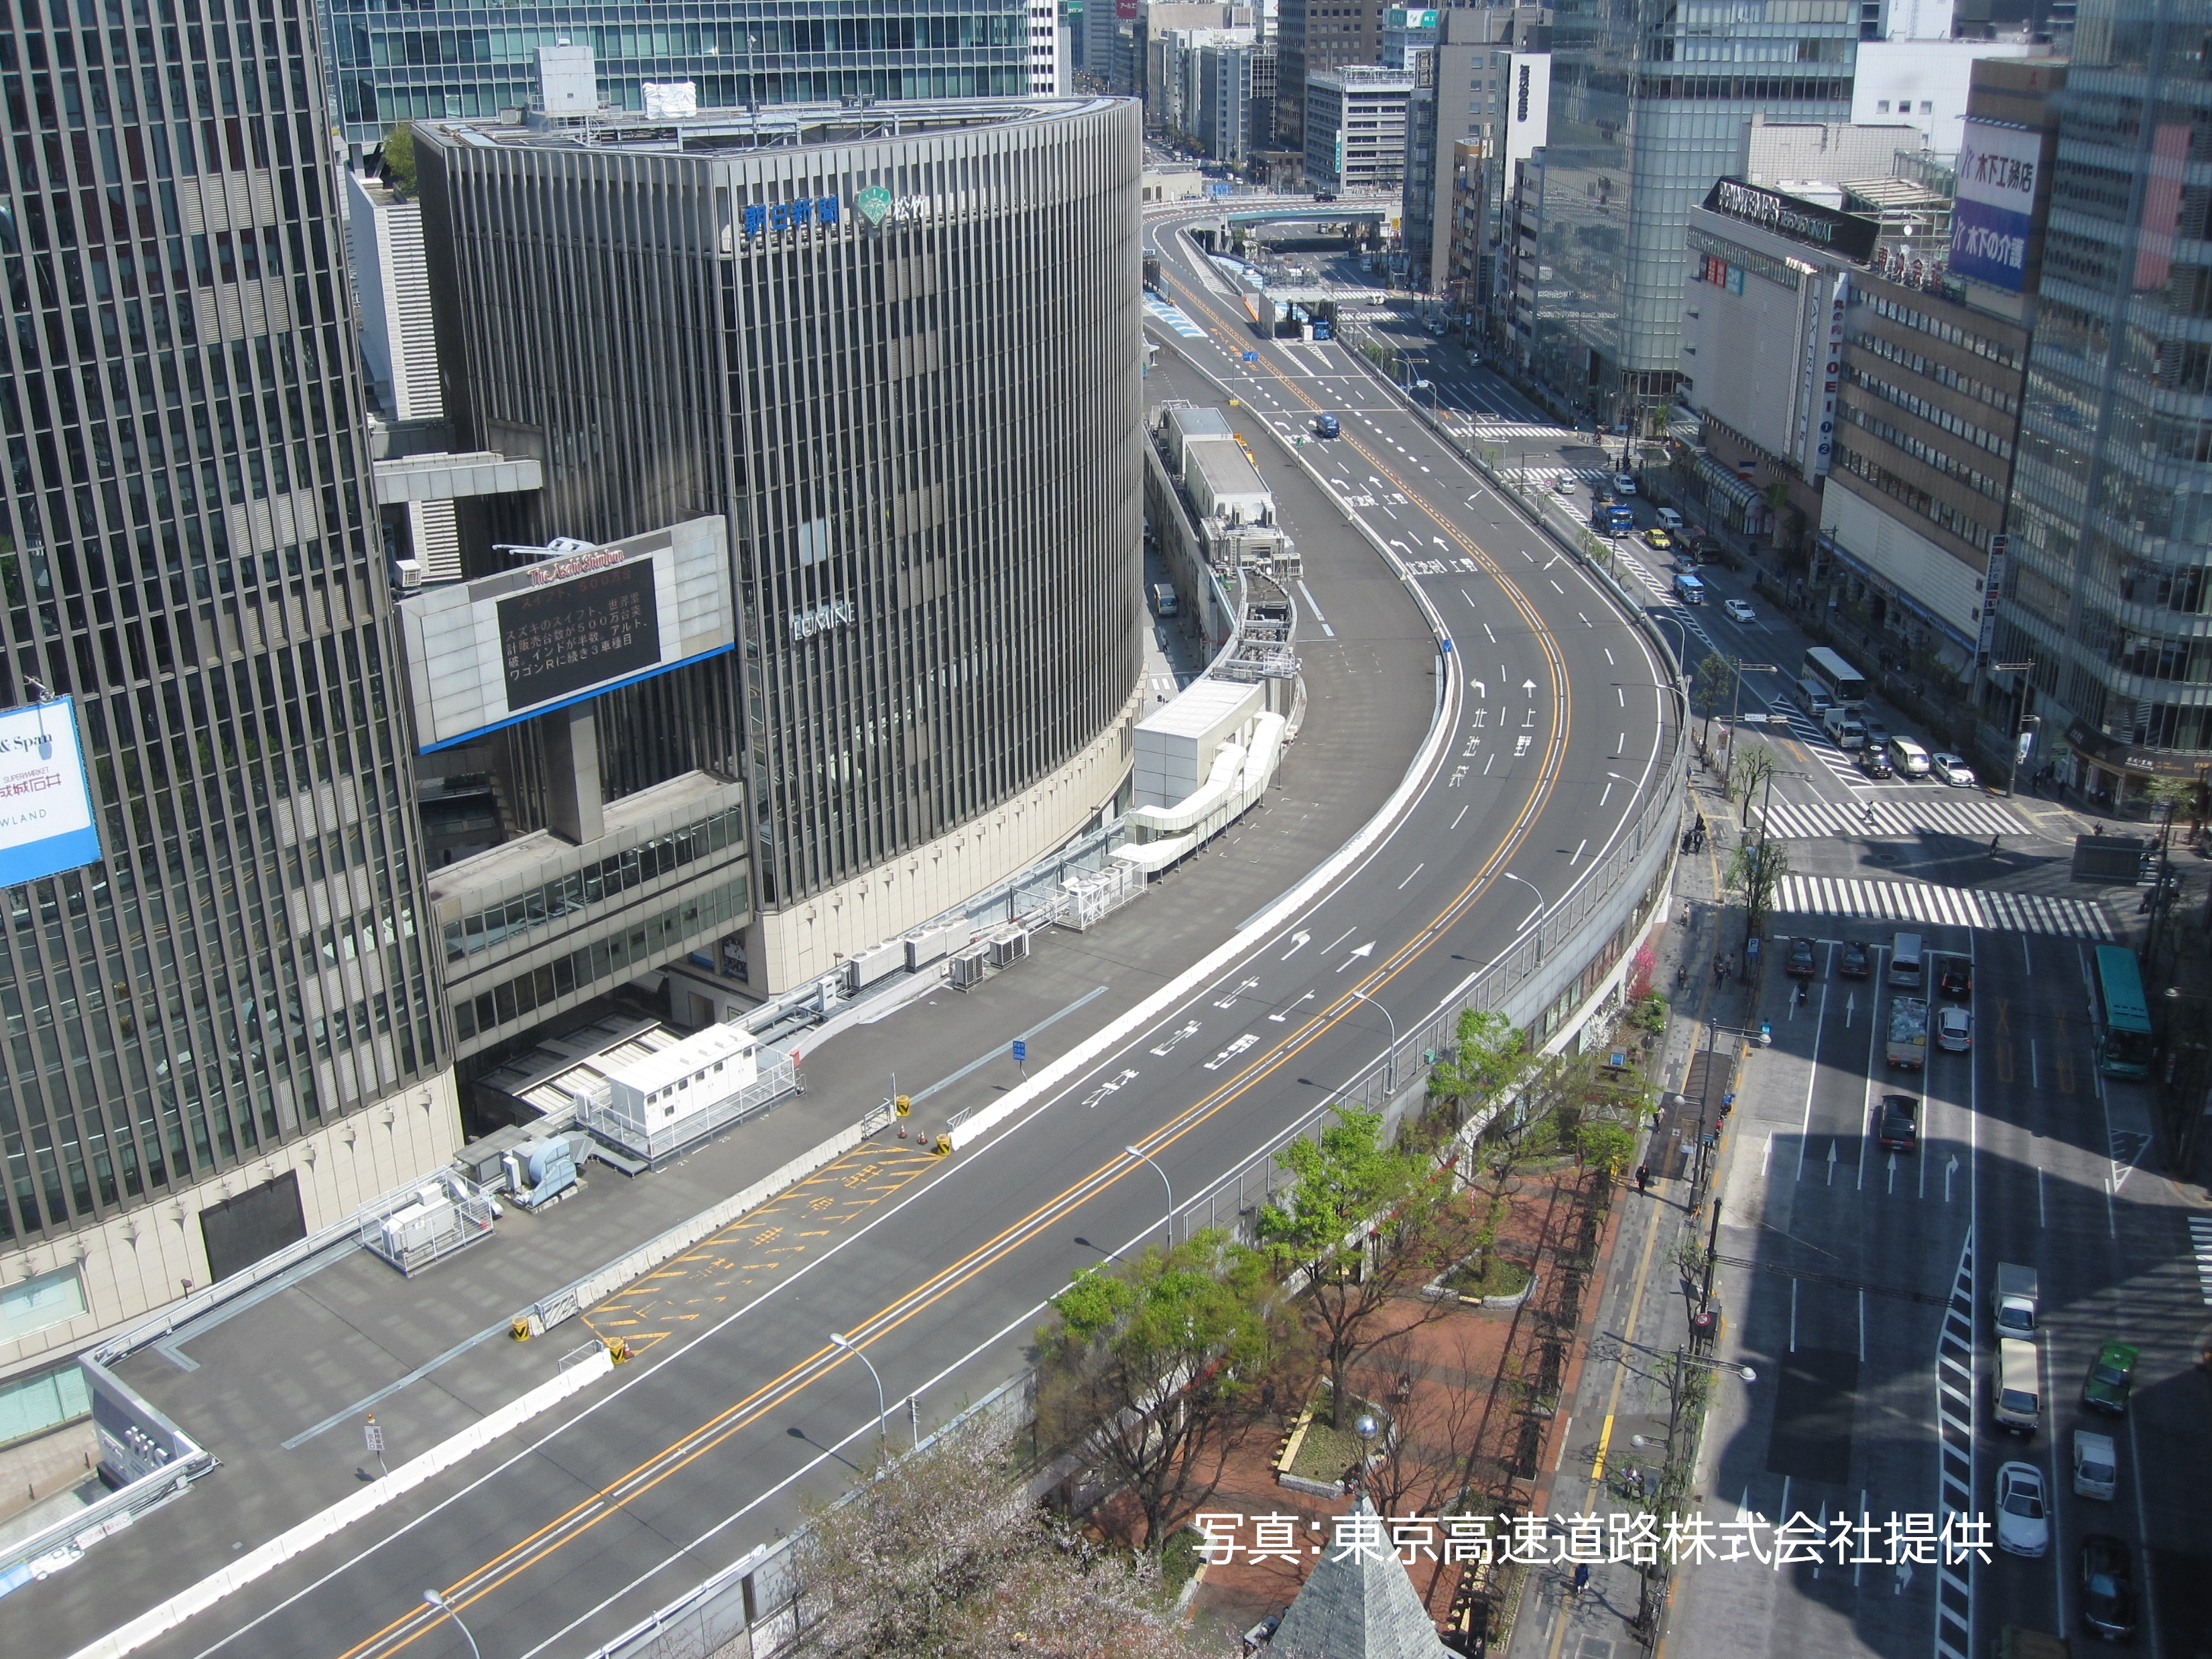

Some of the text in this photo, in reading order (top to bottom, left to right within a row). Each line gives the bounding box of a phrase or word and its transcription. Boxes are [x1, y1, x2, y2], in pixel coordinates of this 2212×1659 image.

[1975, 153, 2034, 192] 木下工務店
[744, 195, 838, 237] 朝日新聞
[893, 194, 925, 221] 松竹
[1965, 225, 2026, 269] 木下の介護
[527, 548, 625, 586] The Asahi Shimbun
[794, 601, 855, 641] LUMINE
[13, 733, 52, 753] Span
[3, 766, 49, 784] SUPERMARKET
[719, 1135, 731, 1144] 20
